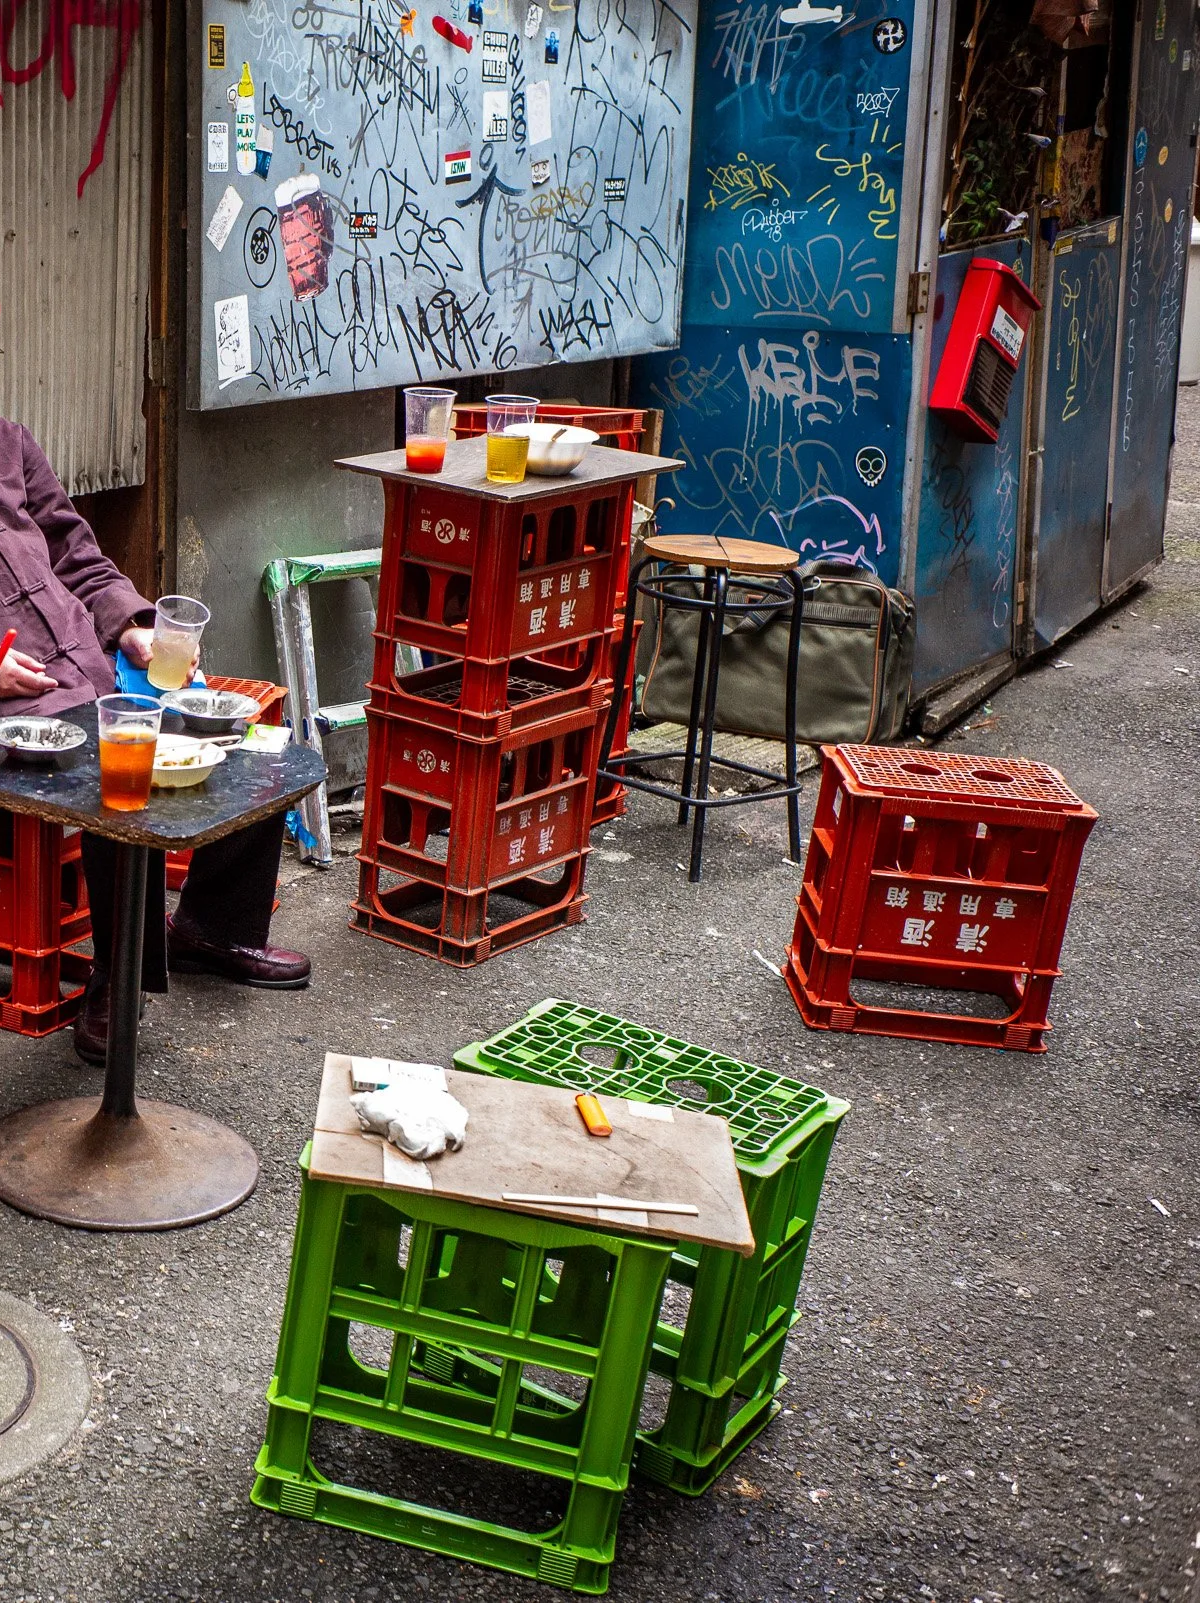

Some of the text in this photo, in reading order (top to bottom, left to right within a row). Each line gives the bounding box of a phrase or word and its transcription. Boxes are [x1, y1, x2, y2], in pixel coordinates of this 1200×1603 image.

[236, 113, 255, 124] LET'S
[237, 142, 256, 152] MORE
[528, 598, 577, 636] 清酒
[507, 825, 555, 866] 清酒
[884, 886, 1018, 920] 専用通箱
[900, 917, 990, 953] 清酒
